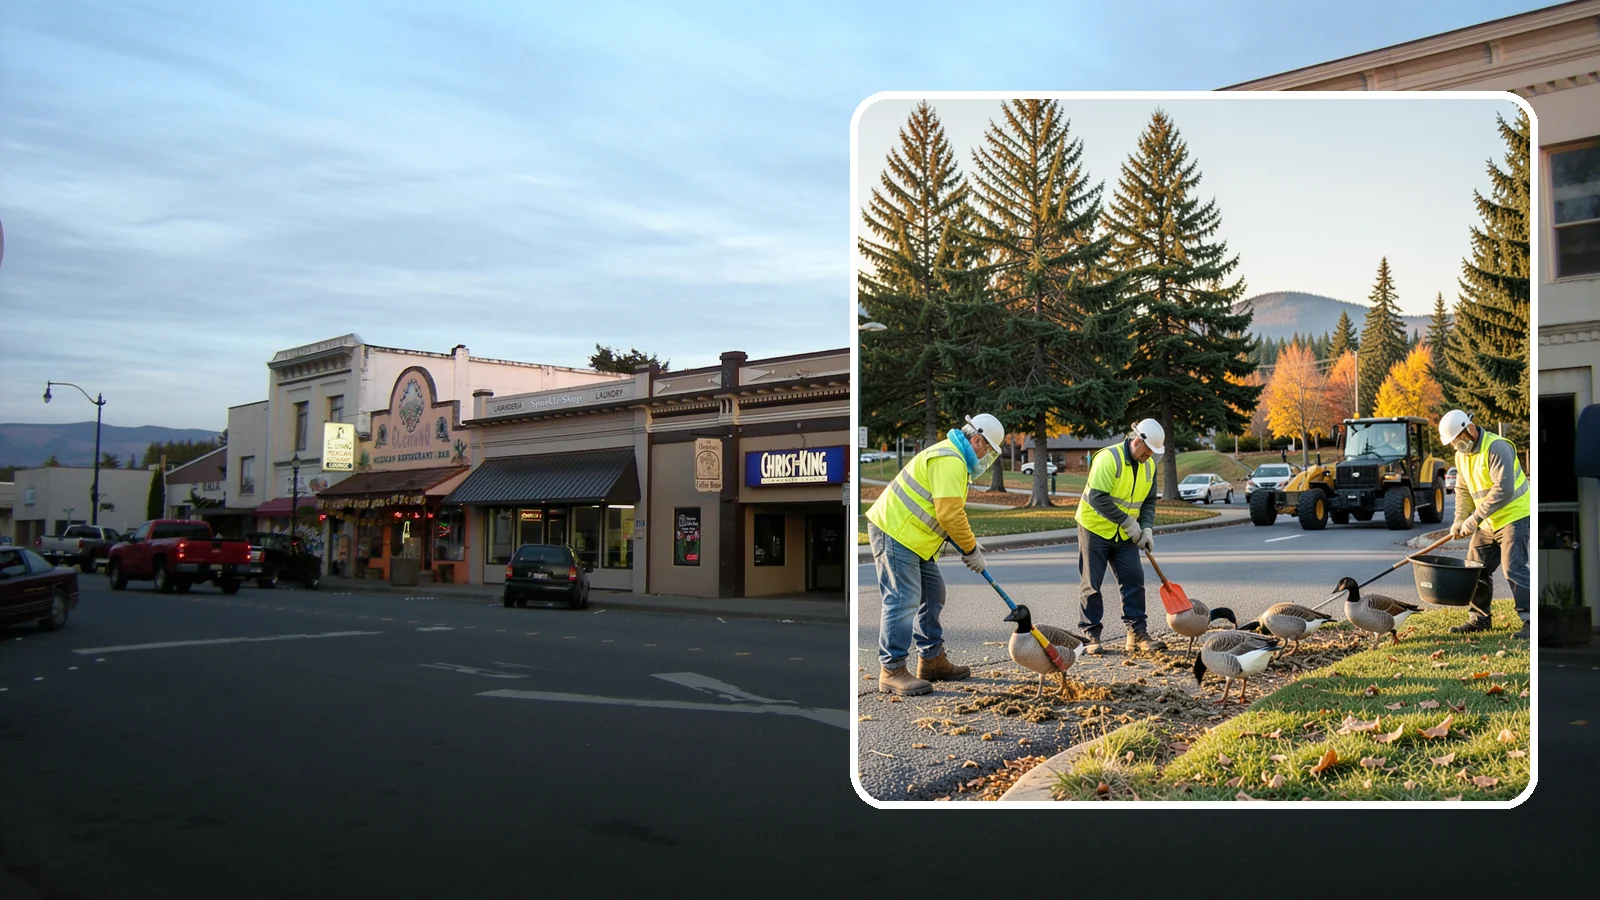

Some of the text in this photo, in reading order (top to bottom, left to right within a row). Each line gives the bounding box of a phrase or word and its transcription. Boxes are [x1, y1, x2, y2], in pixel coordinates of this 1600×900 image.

[493, 402, 522, 413] LAVANDERIA
[562, 394, 582, 405] Shop
[595, 389, 623, 400] LAUNDRY
[373, 450, 450, 464] MEXICAN RESTAURANT BAR
[760, 449, 827, 478] CHRIST KING
[696, 480, 722, 489] Coffee House
